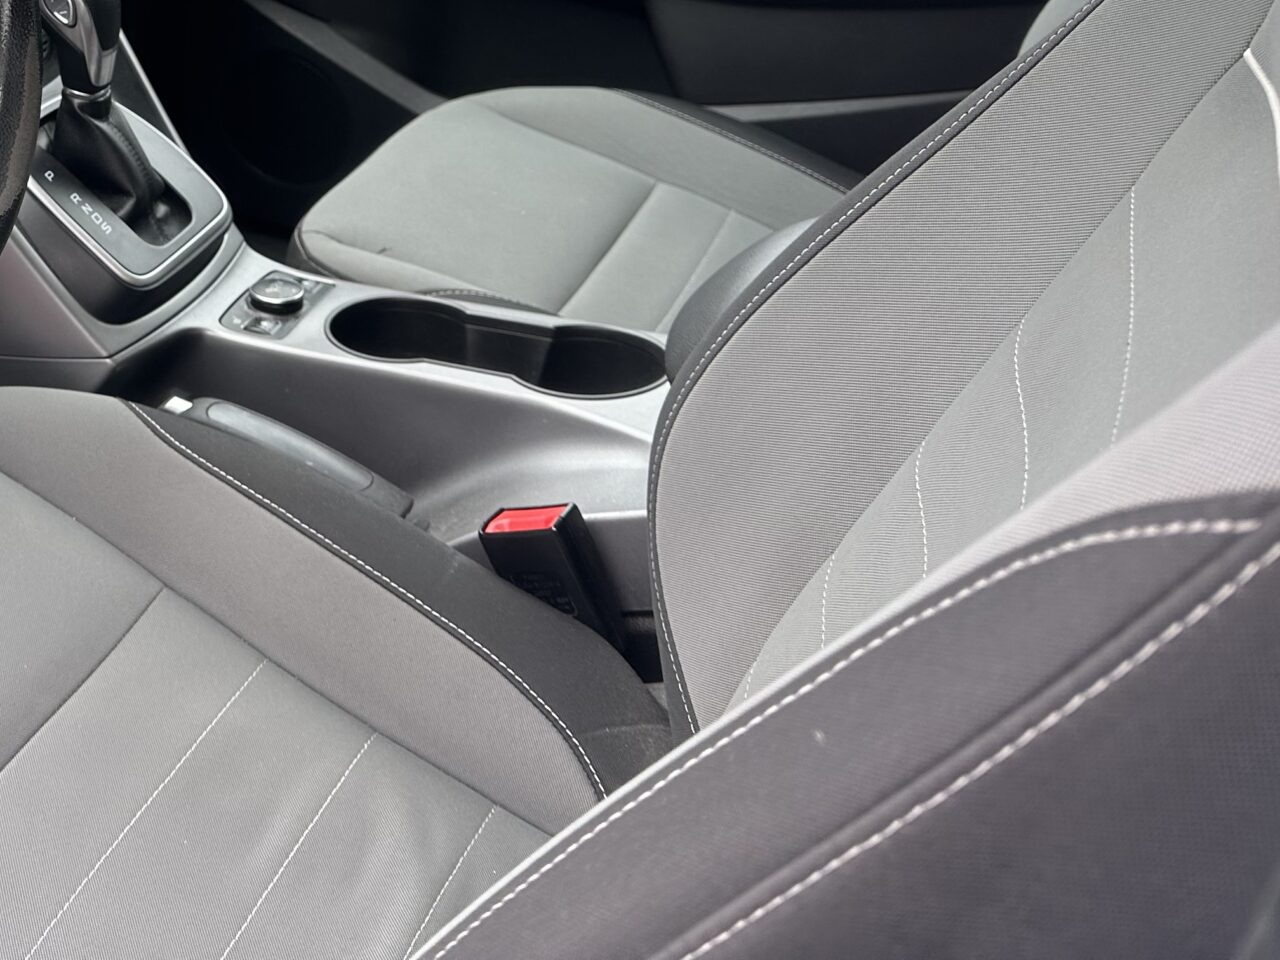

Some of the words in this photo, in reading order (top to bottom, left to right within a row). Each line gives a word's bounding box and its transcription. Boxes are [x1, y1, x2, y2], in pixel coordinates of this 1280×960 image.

[44, 170, 55, 182] P
[70, 192, 82, 205] R
[81, 203, 93, 215] N
[91, 212, 103, 225] D
[101, 221, 112, 234] S
